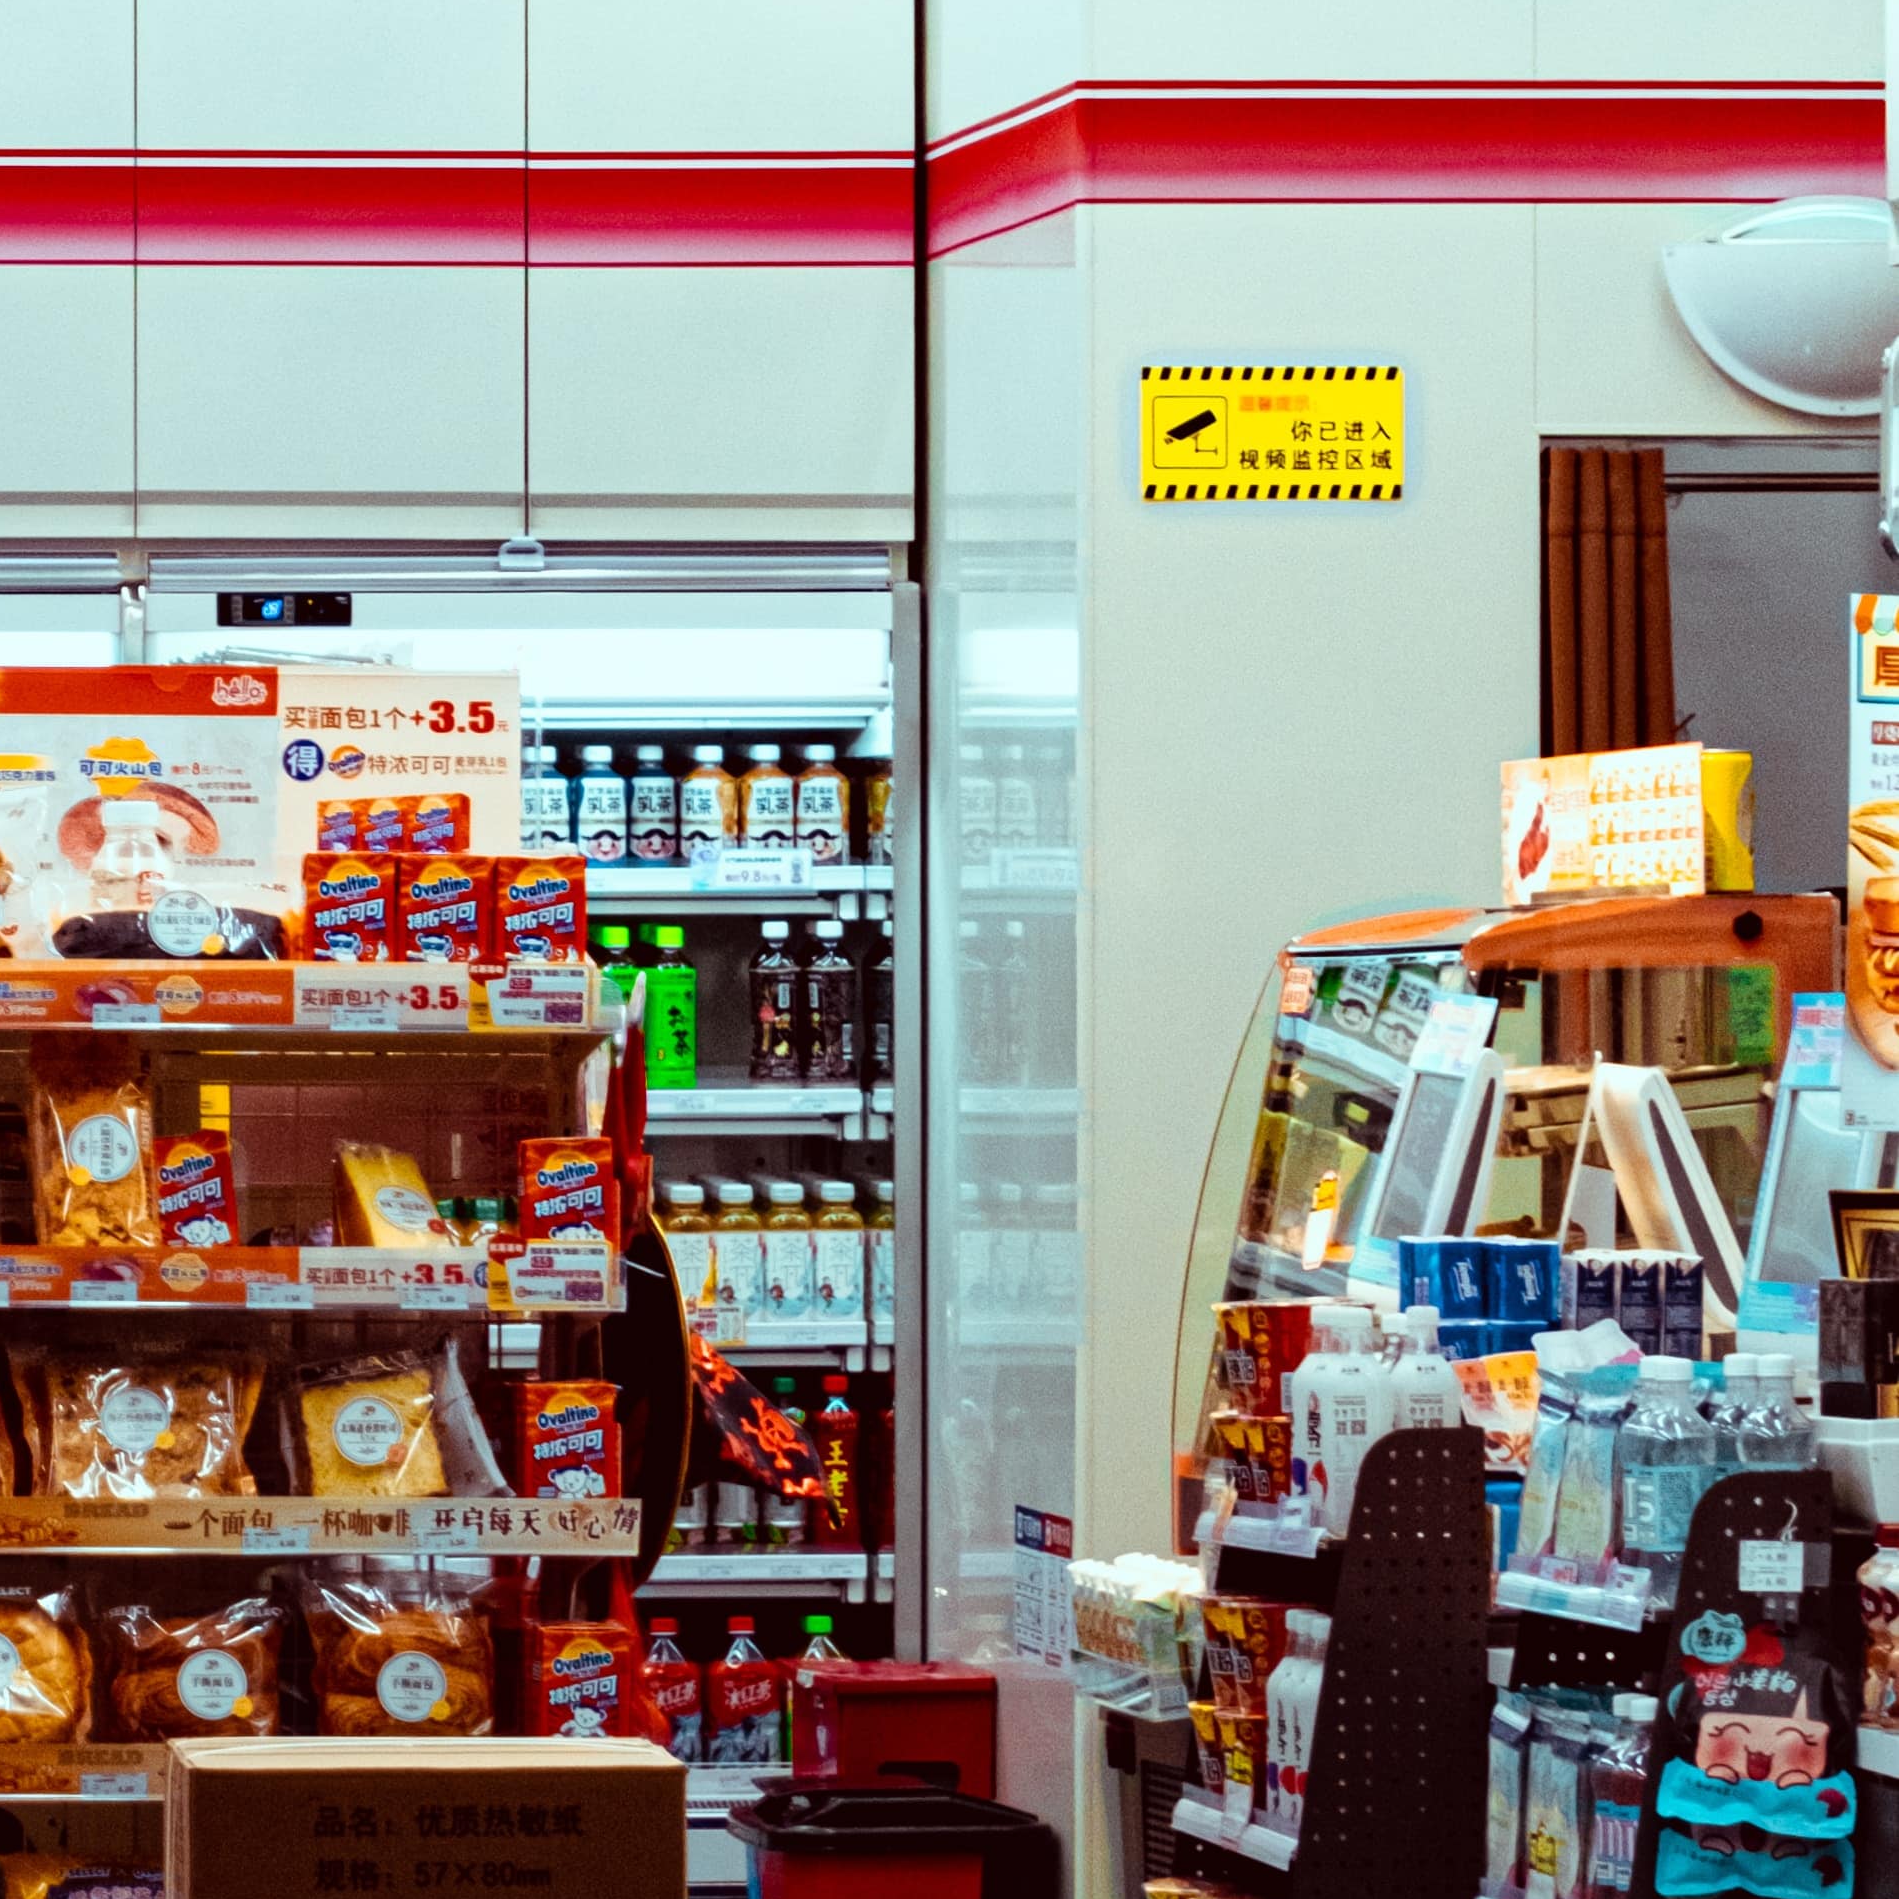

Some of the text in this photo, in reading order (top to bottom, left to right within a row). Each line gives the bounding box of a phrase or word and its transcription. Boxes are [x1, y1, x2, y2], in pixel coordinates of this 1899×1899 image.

[1291, 420, 1392, 441] 你已进入
[1239, 449, 1392, 470] 视频监控区域
[79, 760, 163, 778] 可可火山包
[288, 746, 320, 777] 得
[368, 755, 451, 774] 特浓可可
[319, 874, 380, 898] Ovaltine
[411, 876, 472, 900] Ovaltine
[508, 878, 569, 901] Ovaltine
[314, 899, 385, 929] 特浓可可
[407, 900, 477, 931] 特浓可可
[504, 902, 575, 933] 特浓可可
[159, 1154, 214, 1183] Ovaltine
[537, 1161, 598, 1188] Ovaltine
[537, 1404, 599, 1429] Ovaltine
[533, 1430, 604, 1460] 特浓可可
[552, 1649, 613, 1676] Ovaltine
[548, 1675, 618, 1706] 特浓可可
